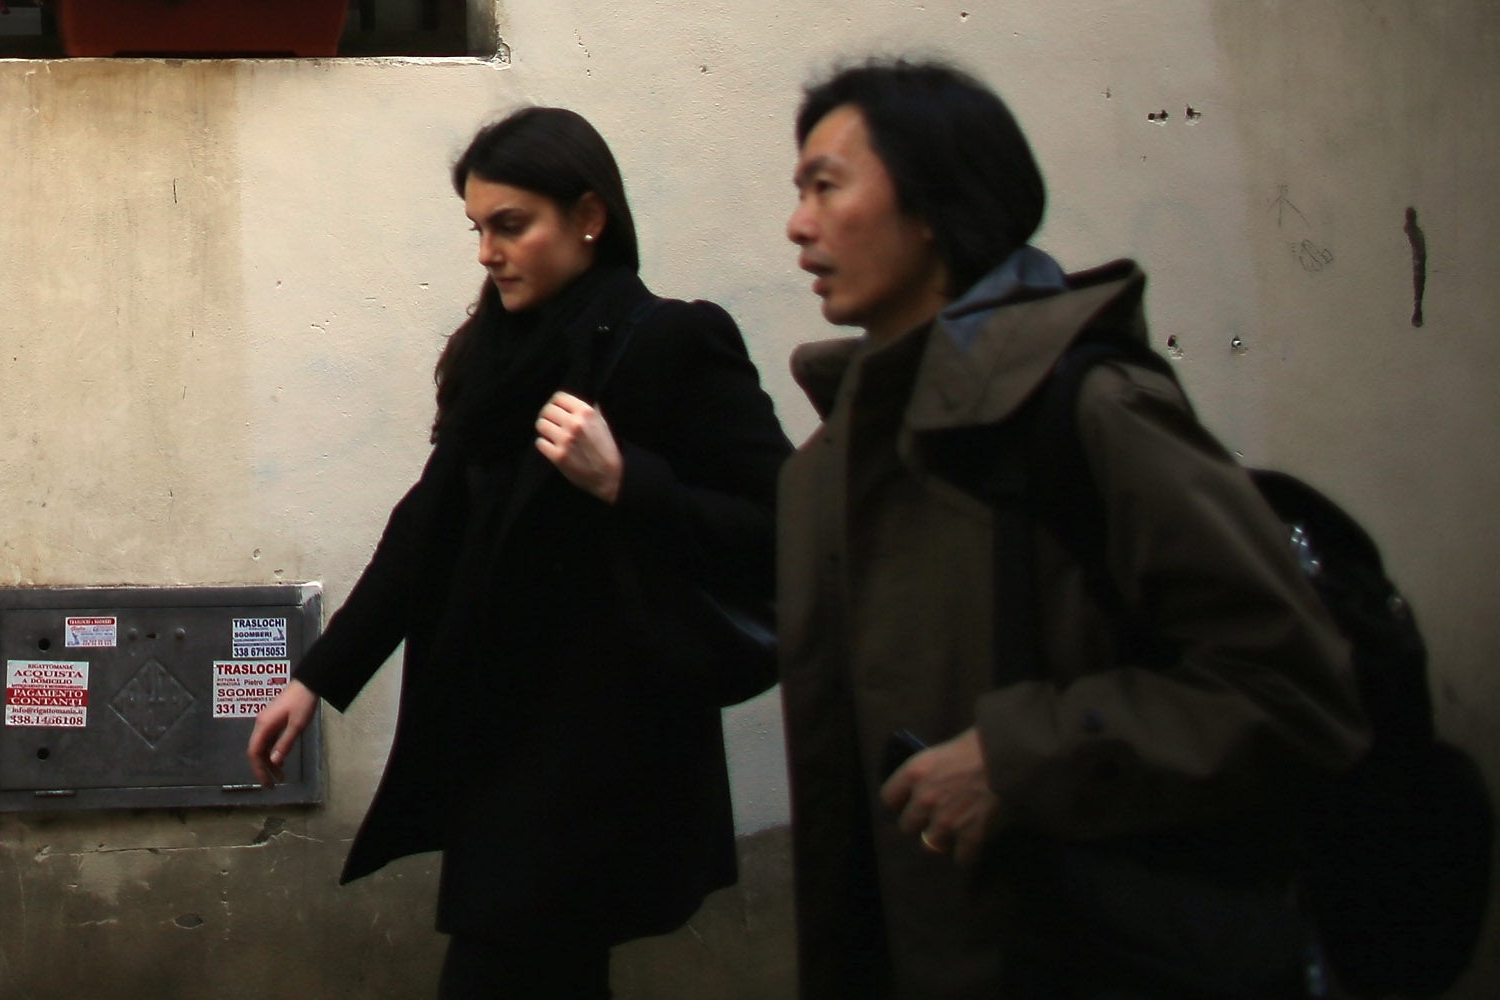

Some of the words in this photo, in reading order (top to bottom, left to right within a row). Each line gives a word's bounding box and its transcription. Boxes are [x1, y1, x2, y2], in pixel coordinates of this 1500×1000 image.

[233, 618, 285, 628] TRASLOCHI
[233, 647, 249, 657] 338
[250, 647, 285, 657] 6715053
[14, 669, 84, 679] ACQUISTA
[216, 663, 287, 675] TRASLOCHI
[13, 689, 84, 698] PAGAMENTO
[217, 687, 283, 697] SGOMBER
[11, 697, 83, 706] CONTANTI
[216, 703, 235, 714] 331
